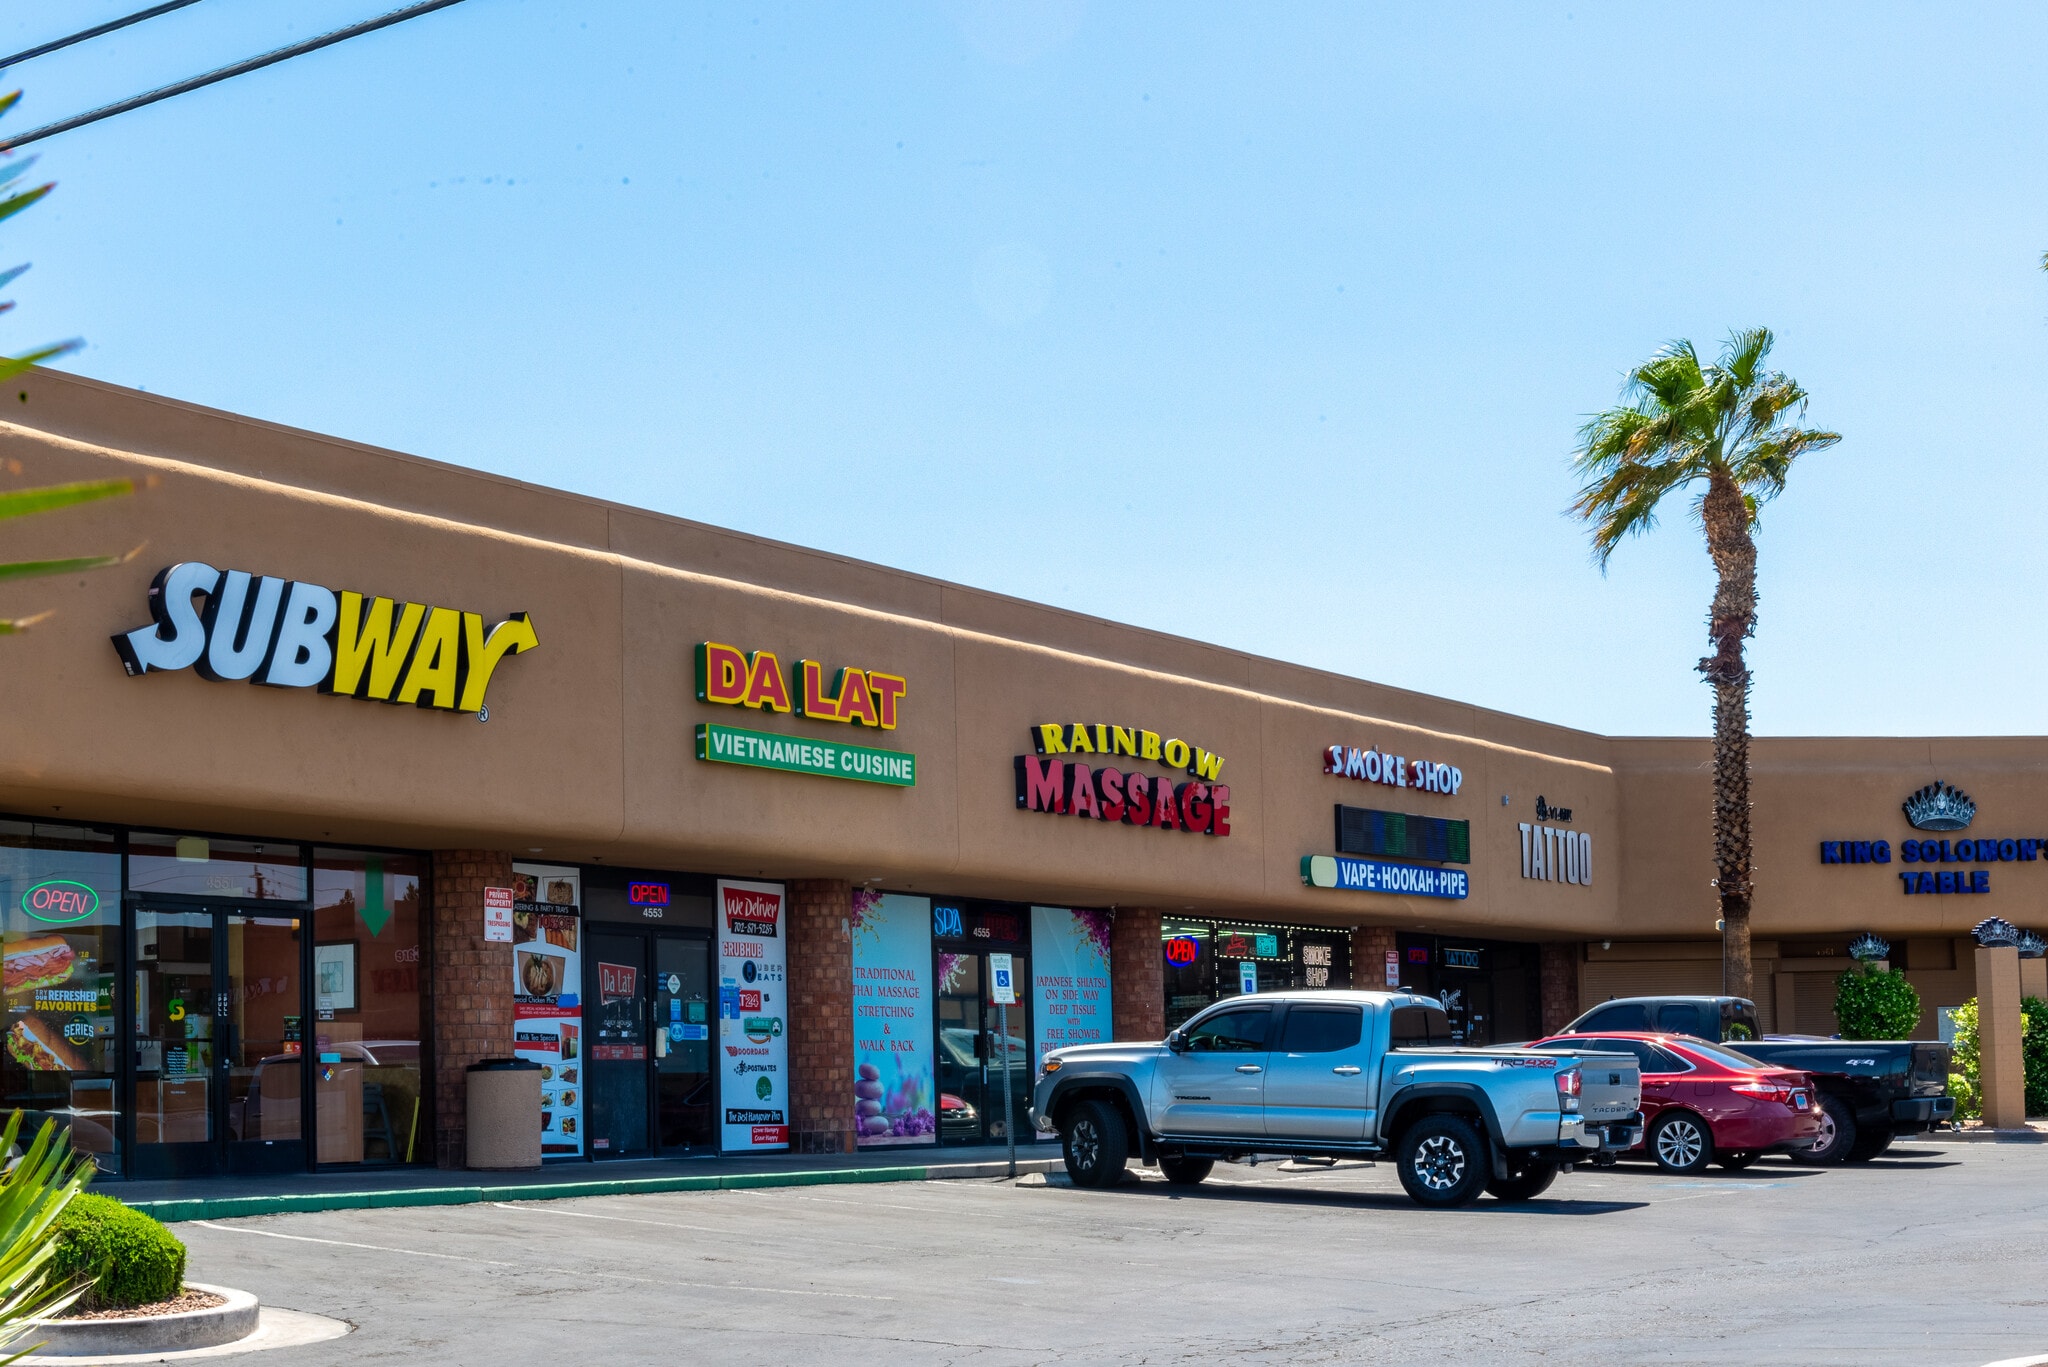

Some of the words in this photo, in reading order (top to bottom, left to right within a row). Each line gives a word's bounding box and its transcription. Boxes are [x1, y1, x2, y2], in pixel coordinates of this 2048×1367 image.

[112, 561, 539, 713] SUBWAY
[702, 642, 791, 712] DA
[798, 659, 907, 730] LAT
[712, 731, 835, 769] VIETNAMESE
[841, 756, 912, 780] CUISINE
[1036, 723, 1225, 781] RAINBOW
[1326, 745, 1406, 787] SMOKE
[1409, 760, 1462, 795] SHOP
[1020, 754, 1230, 837] MASSAGE
[1518, 822, 1592, 886] TATTOO
[1821, 840, 1891, 864] KING
[1901, 838, 2048, 863] SOLOMON'
[1341, 862, 1376, 888] VAPE
[1382, 866, 1434, 893] HOOKAH
[1440, 872, 1466, 896] PIPE
[1899, 871, 1990, 895] TABLE
[32, 888, 88, 914] OPEN
[488, 891, 509, 899] PRIVATE
[630, 885, 668, 904] OPEN
[486, 898, 511, 907] PROPERTY
[513, 903, 534, 912] ATERING
[540, 904, 553, 913] PARTY
[555, 905, 569, 914] TRAYS
[727, 896, 743, 916] We
[744, 896, 777, 919] Deliver
[495, 911, 503, 920] NO
[642, 908, 663, 919] 4553
[734, 921, 773, 935] 702-871-5285
[934, 906, 963, 936] SPA
[973, 927, 990, 938] 4555
[722, 942, 763, 958] GRUBHUB
[1167, 939, 1196, 962] OPEN
[1302, 945, 1332, 966] SMOKE
[1445, 951, 1479, 967] TATTOO
[757, 963, 783, 972] UBER
[855, 967, 916, 981] TRADITIONAL
[603, 969, 615, 992] Da
[617, 969, 632, 993] Lat
[757, 973, 783, 982] EATS
[1036, 976, 1073, 987] JAPANESE
[1077, 977, 1107, 988] SHIATSU
[1306, 967, 1329, 987] SHOP
[48, 989, 97, 1001] REFRESHED
[852, 984, 873, 996] THAI
[878, 986, 920, 998] MASSAGE
[1045, 989, 1058, 1000] ON
[1062, 990, 1079, 1000] SIDE
[1082, 990, 1099, 1000] WAY
[35, 1001, 97, 1012] FAVORITES
[739, 994, 760, 1008] T24
[858, 1005, 915, 1018] STRETCHING
[1049, 1004, 1068, 1015] DEEP
[1072, 1004, 1097, 1015] TISSUE
[63, 1023, 94, 1038] SERIES
[883, 1023, 891, 1035] &
[1047, 1028, 1064, 1039] FREE
[1068, 1029, 1101, 1039] SHOWER
[738, 1047, 769, 1056] DOORDASH
[859, 1039, 885, 1051] WALK
[890, 1040, 915, 1052] BACK
[748, 1064, 777, 1072] POSTMATES
[737, 1111, 748, 1122] Best
